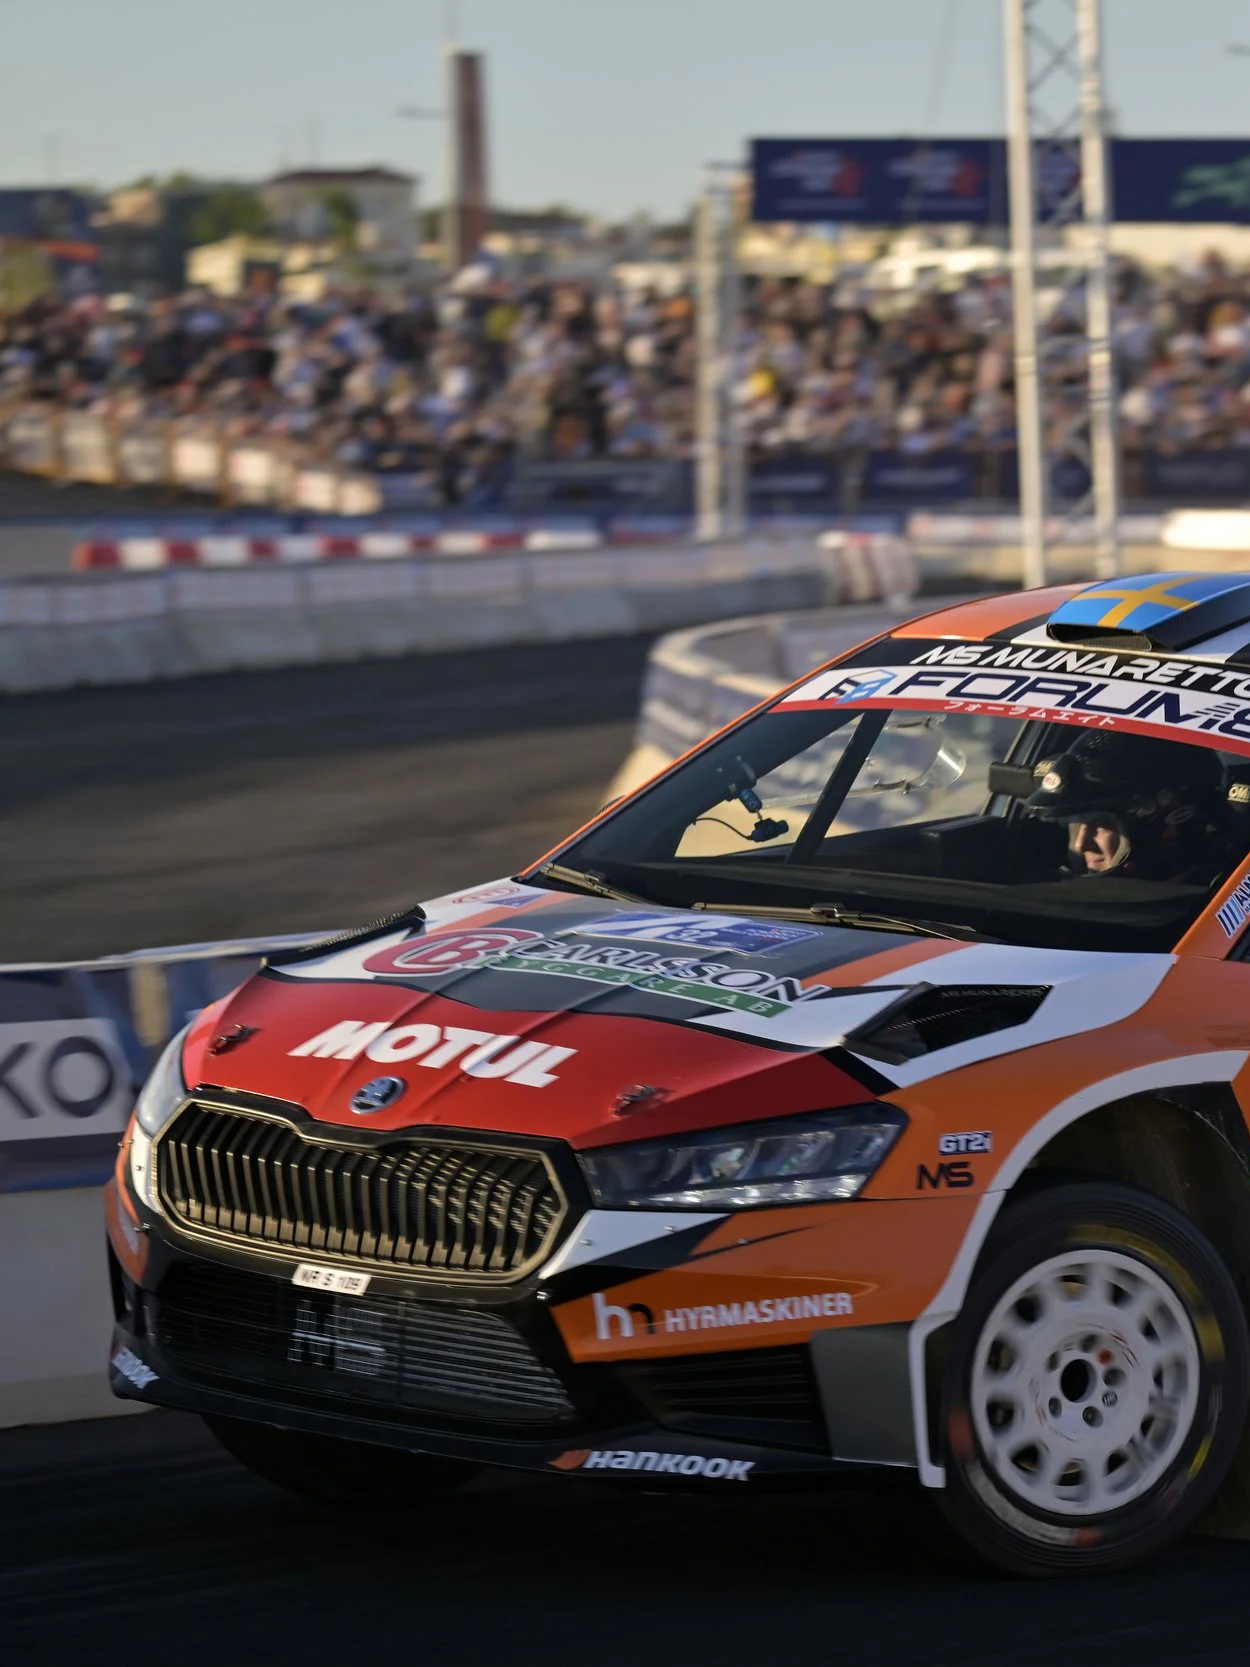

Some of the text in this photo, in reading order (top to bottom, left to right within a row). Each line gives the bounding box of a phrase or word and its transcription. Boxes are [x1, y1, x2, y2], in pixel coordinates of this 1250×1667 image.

[910, 644, 994, 666] MS
[944, 701, 1116, 727] フォーラムエイト
[499, 937, 833, 1003] CARLSSON
[286, 1019, 580, 1089] MOTUL
[916, 1161, 974, 1190] MS
[663, 1292, 854, 1333] HYRMASKINER
